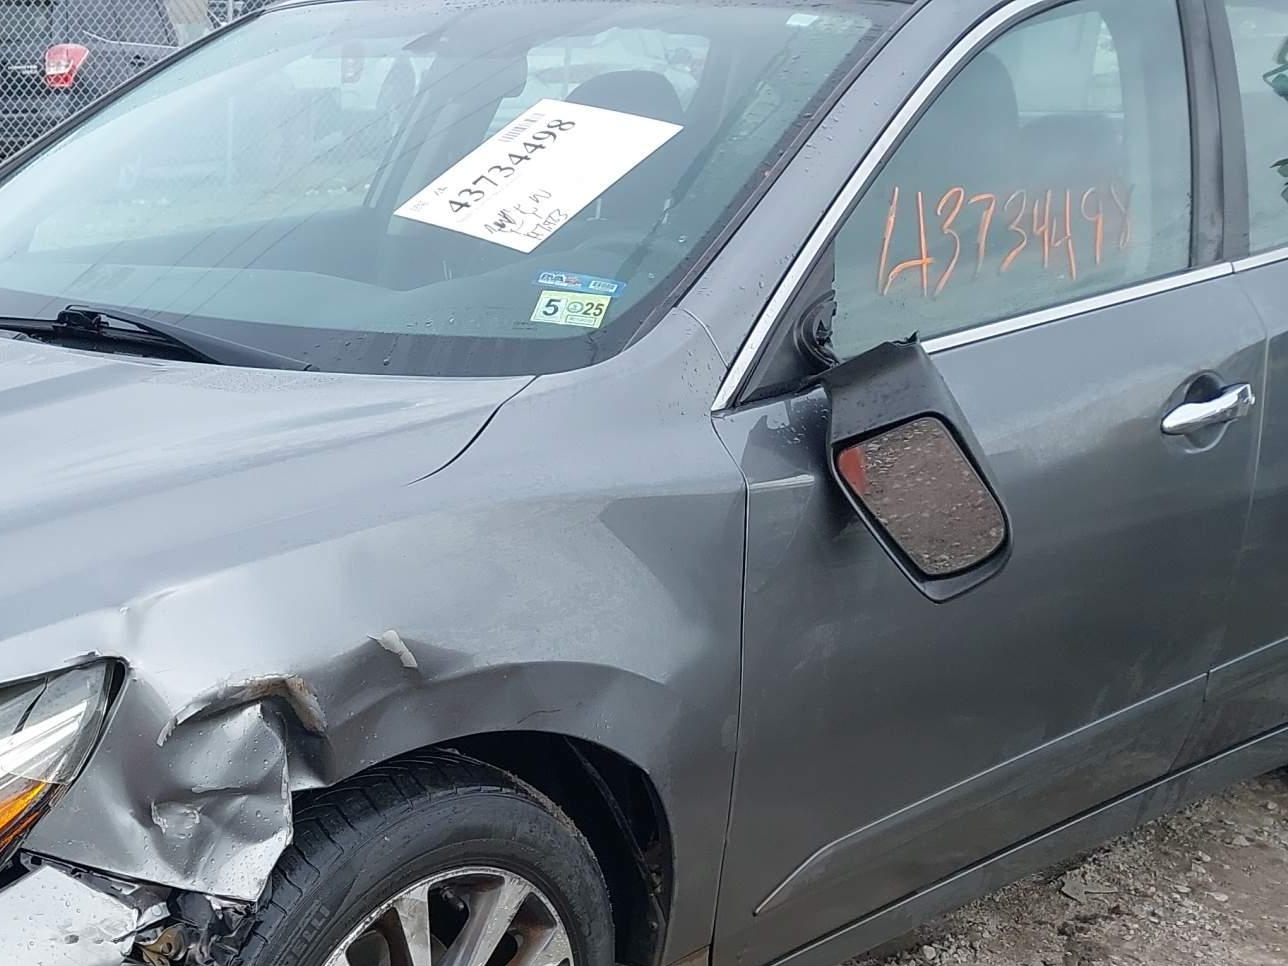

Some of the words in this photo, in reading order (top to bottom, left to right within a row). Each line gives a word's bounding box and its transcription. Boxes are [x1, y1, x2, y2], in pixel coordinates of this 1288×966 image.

[448, 118, 576, 213] 43734498
[542, 298, 561, 316] 5
[582, 302, 605, 317] 25
